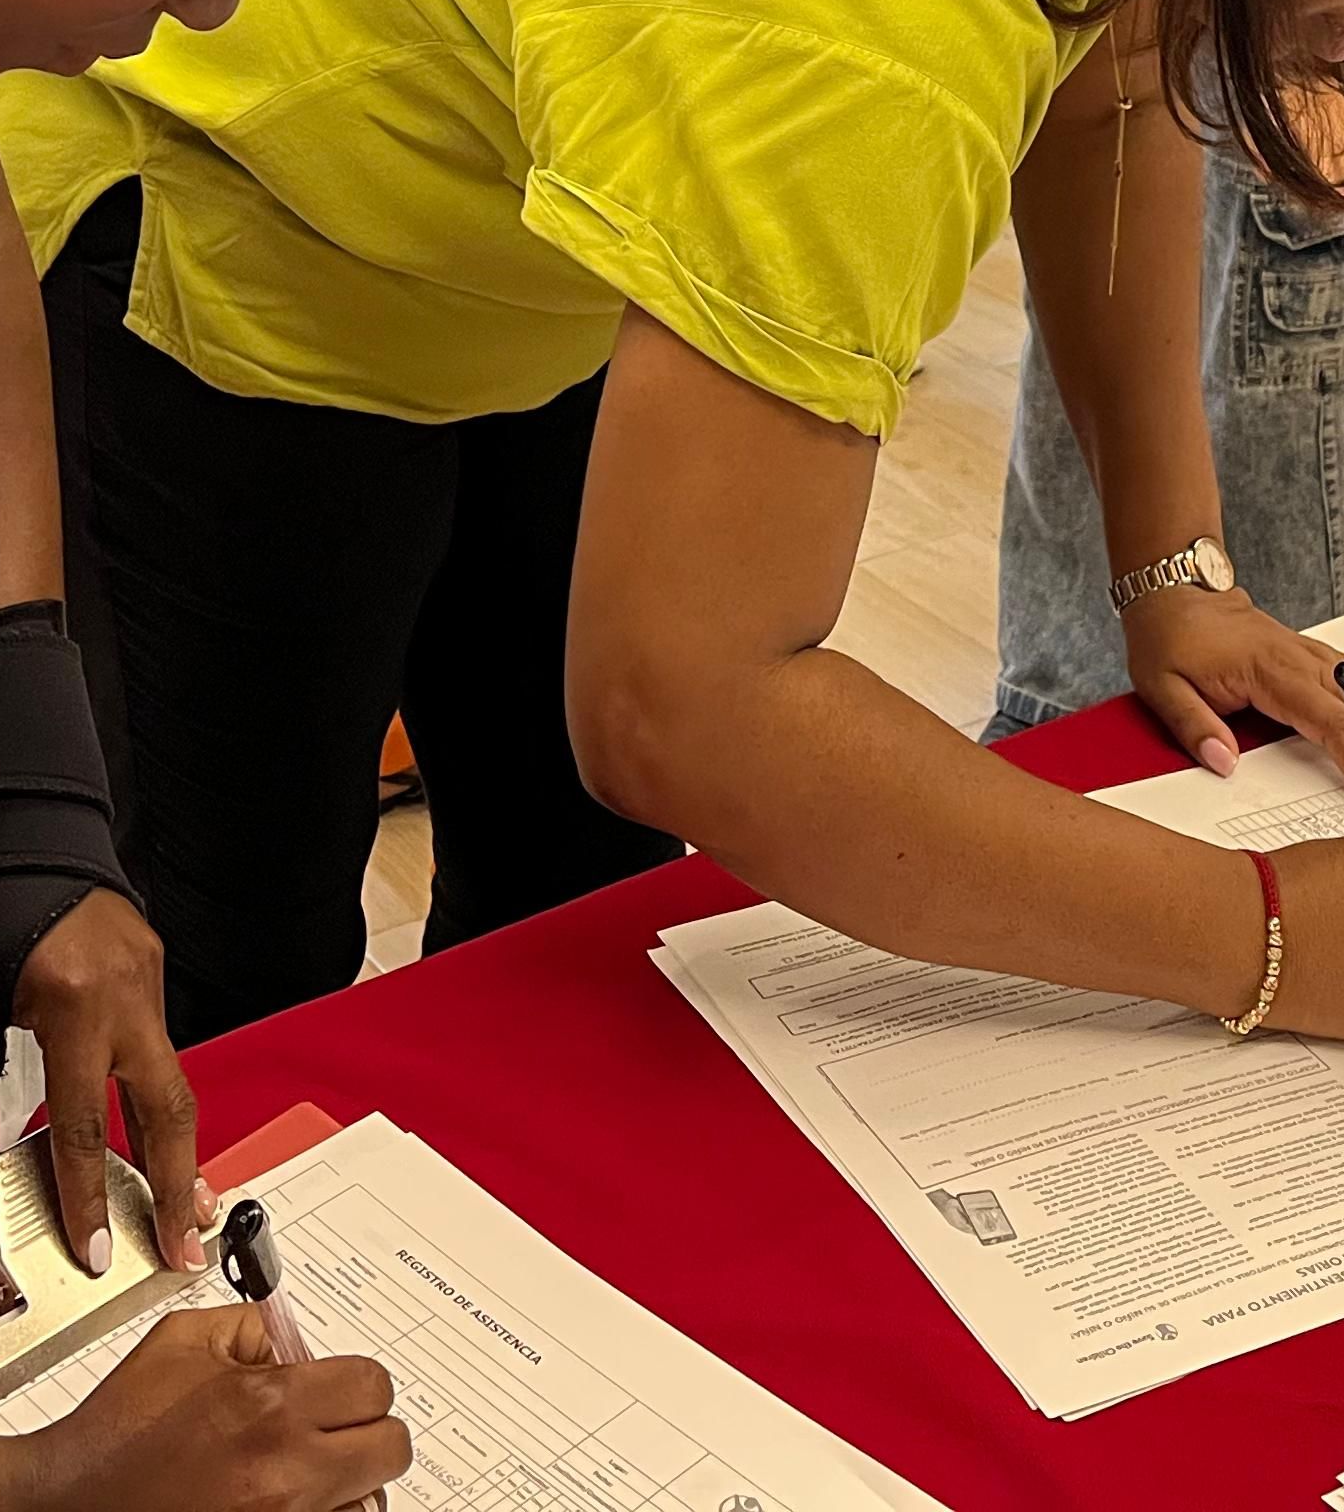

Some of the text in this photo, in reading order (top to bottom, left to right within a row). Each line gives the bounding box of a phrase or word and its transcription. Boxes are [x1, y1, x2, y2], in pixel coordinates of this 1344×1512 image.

[395, 1250, 541, 1365] REGISTRO DE ASISTENCIA
[1202, 1307, 1246, 1326] PARA
